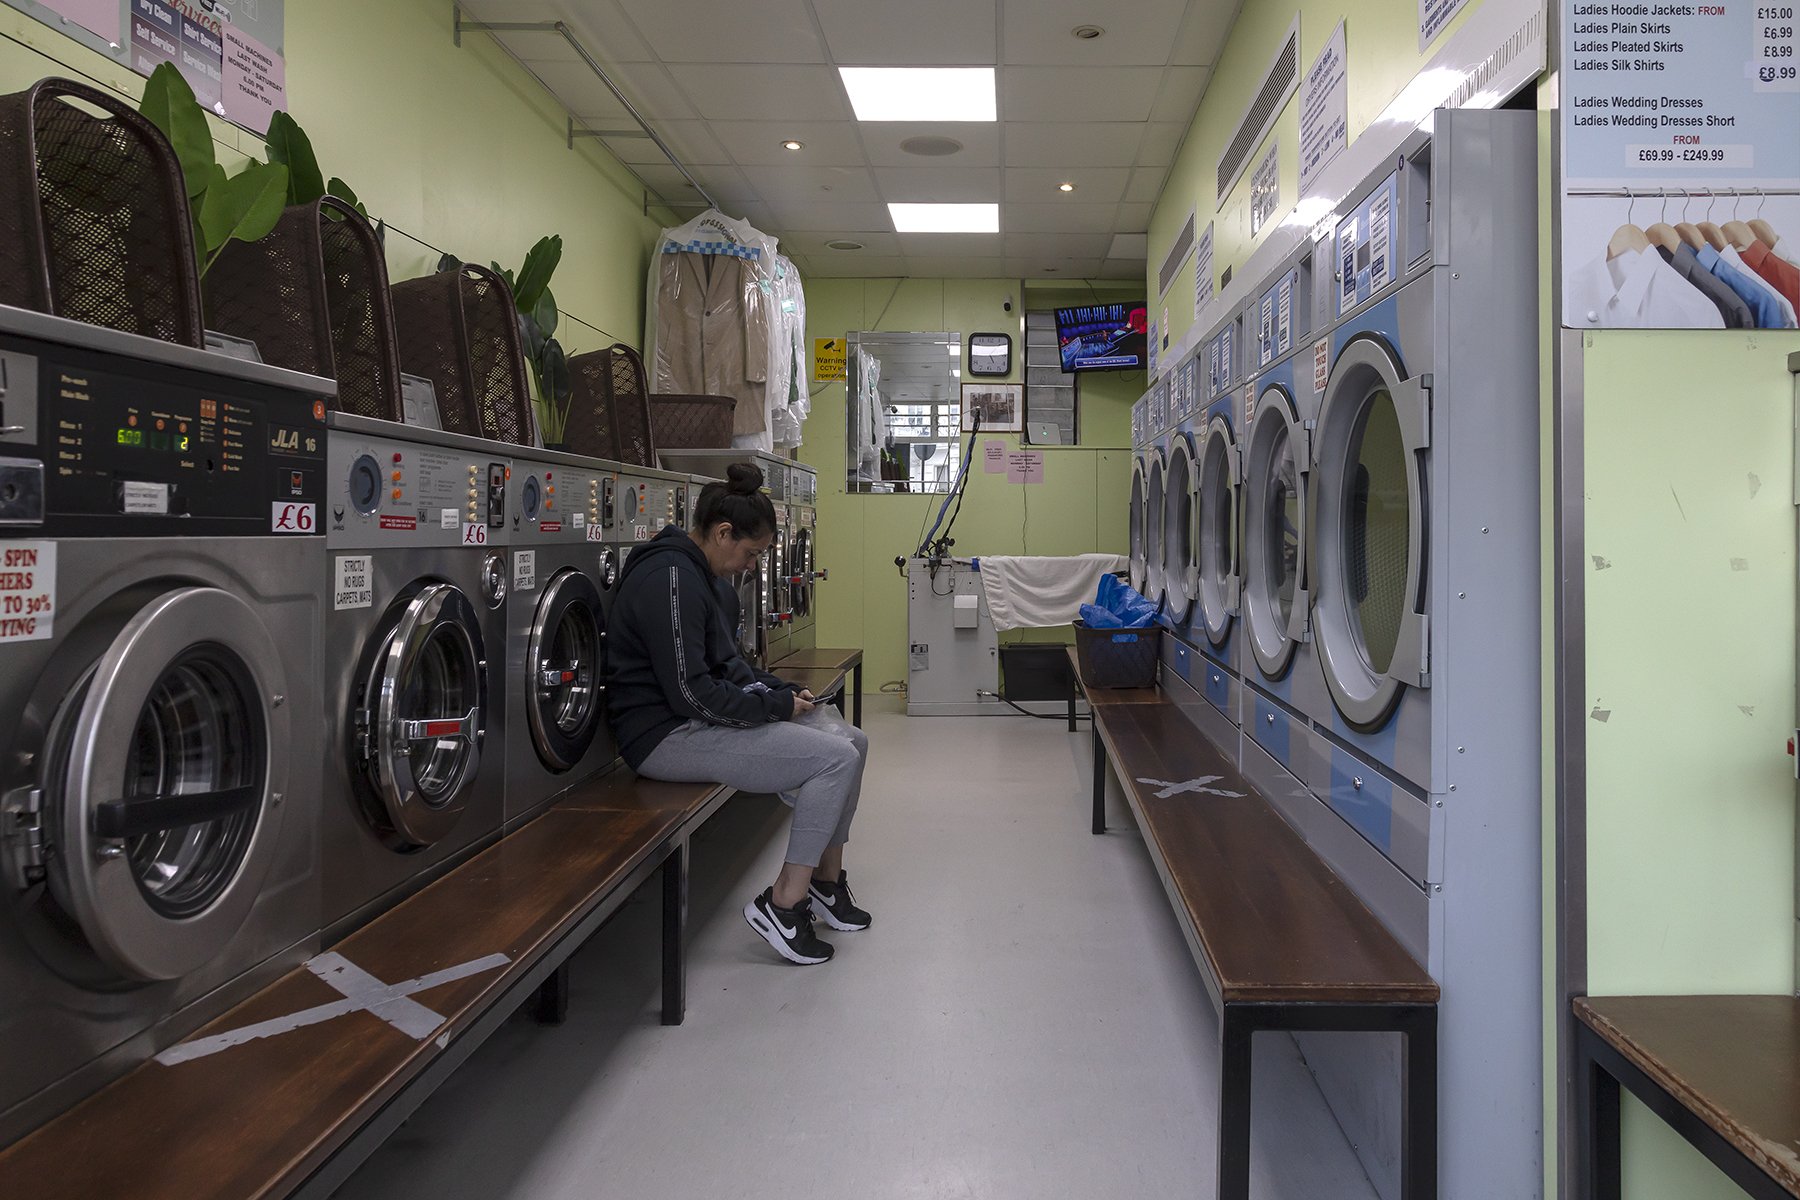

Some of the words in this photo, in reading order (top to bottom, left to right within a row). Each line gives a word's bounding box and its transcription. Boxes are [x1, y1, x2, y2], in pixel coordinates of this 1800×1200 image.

[1574, 4, 1608, 15] Ladies
[1612, 4, 1648, 15] Hoodie
[1651, 5, 1694, 15] Jackets:
[1698, 6, 1724, 15] FROM
[1758, 8, 1792, 19] £15.00
[1574, 23, 1608, 33] Ladies
[1612, 23, 1637, 33] Plain
[1641, 23, 1670, 34] Skirts
[1764, 27, 1792, 39] £6.99
[151, 32, 175, 56] Service
[226, 33, 245, 50] SMALL
[245, 43, 272, 67] MACHINES
[1574, 41, 1608, 52] Ladies
[1612, 41, 1650, 52] Pleated
[1653, 41, 1683, 52] Skirts
[1764, 46, 1792, 57] £8.99
[237, 51, 251, 63] LAST
[252, 61, 268, 74] WASH
[1574, 59, 1608, 70] Ladies
[1612, 59, 1631, 70] Silk
[1634, 60, 1664, 70] Shirts
[207, 64, 221, 82] Was
[228, 56, 251, 74] MONDAY
[255, 72, 282, 92] SATURDAY
[1759, 67, 1796, 80] £8.99
[238, 83, 259, 99] THANK
[260, 95, 272, 106] YOU
[255, 82, 264, 93] PM
[1575, 96, 1608, 107] Ladies
[1611, 97, 1657, 110] Wedding
[1661, 97, 1703, 108] Dresses
[1575, 115, 1608, 126] Ladies
[1612, 115, 1657, 129] Wedding
[1661, 115, 1703, 126] Dresses
[1706, 115, 1735, 126] Short
[1674, 136, 1700, 144] FROM
[1639, 150, 1673, 161] £69.99
[1683, 150, 1723, 161] £249.99
[816, 357, 847, 366] Warning
[180, 437, 188, 450] 2
[272, 429, 299, 449] JLA
[305, 438, 316, 452] 16
[276, 504, 312, 530] £6
[464, 524, 485, 544] £6
[588, 526, 601, 540] £6
[636, 527, 646, 539] £6
[4, 549, 38, 567] SPIN
[4, 595, 22, 614] TO
[26, 593, 52, 615] 30%
[0, 617, 36, 637] YING
